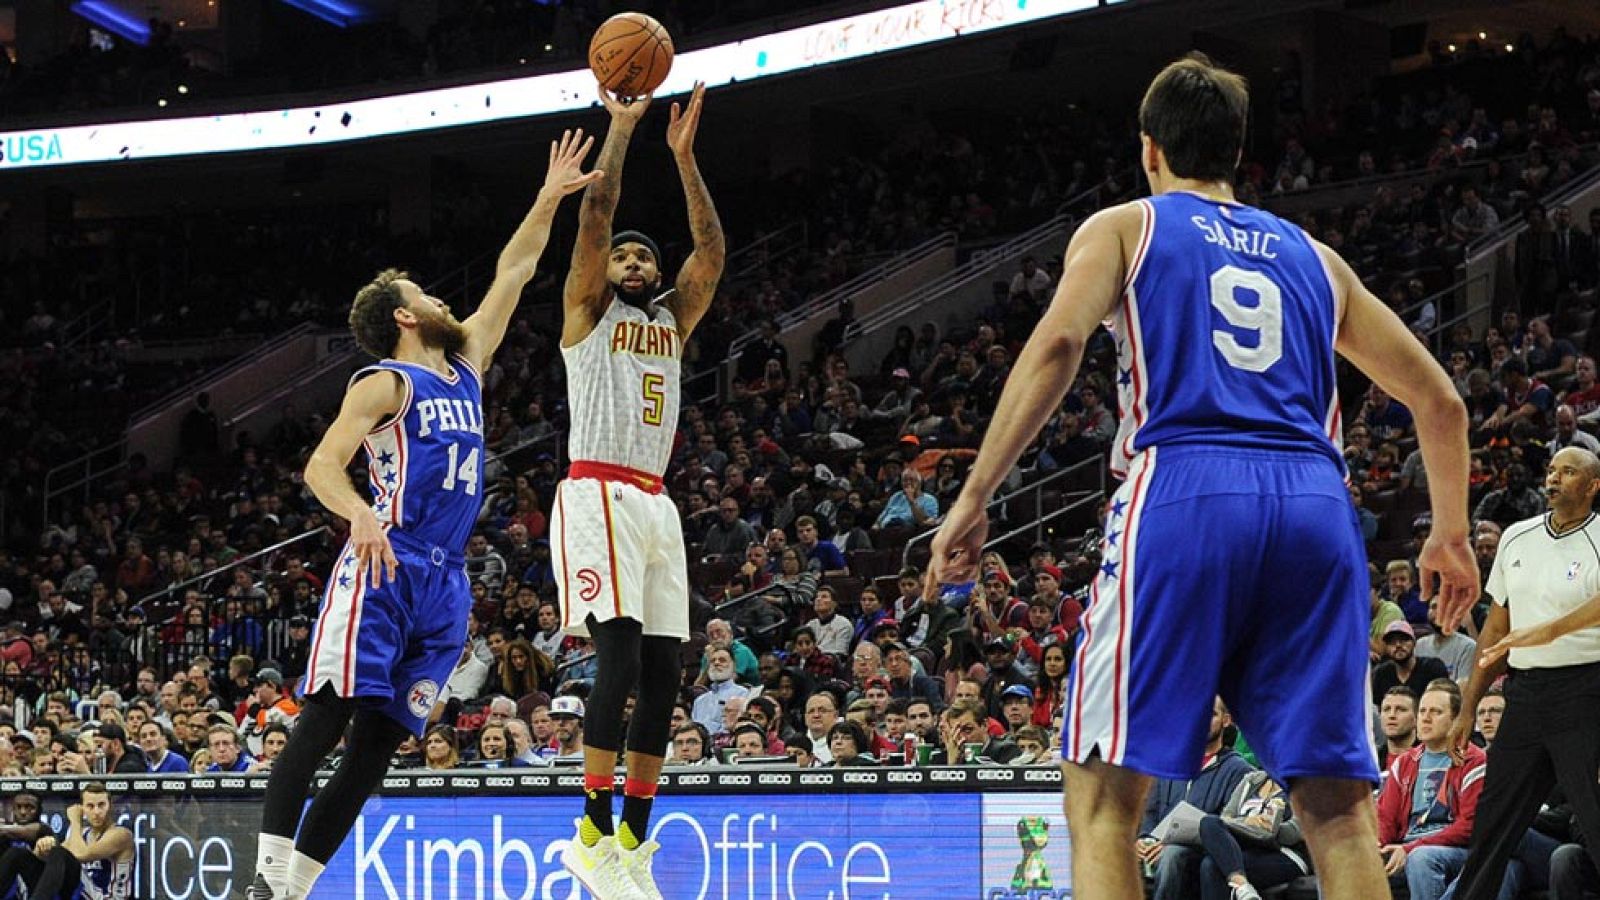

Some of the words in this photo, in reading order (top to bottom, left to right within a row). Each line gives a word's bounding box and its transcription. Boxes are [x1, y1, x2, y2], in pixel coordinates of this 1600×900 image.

[0, 133, 63, 163] USA
[1191, 215, 1281, 259] SARIC
[1210, 264, 1283, 372] 9
[416, 398, 483, 438] PHIL
[643, 372, 664, 426] 5
[442, 442, 479, 496] 14
[355, 815, 584, 900] Kimba
[645, 811, 891, 900] Office
